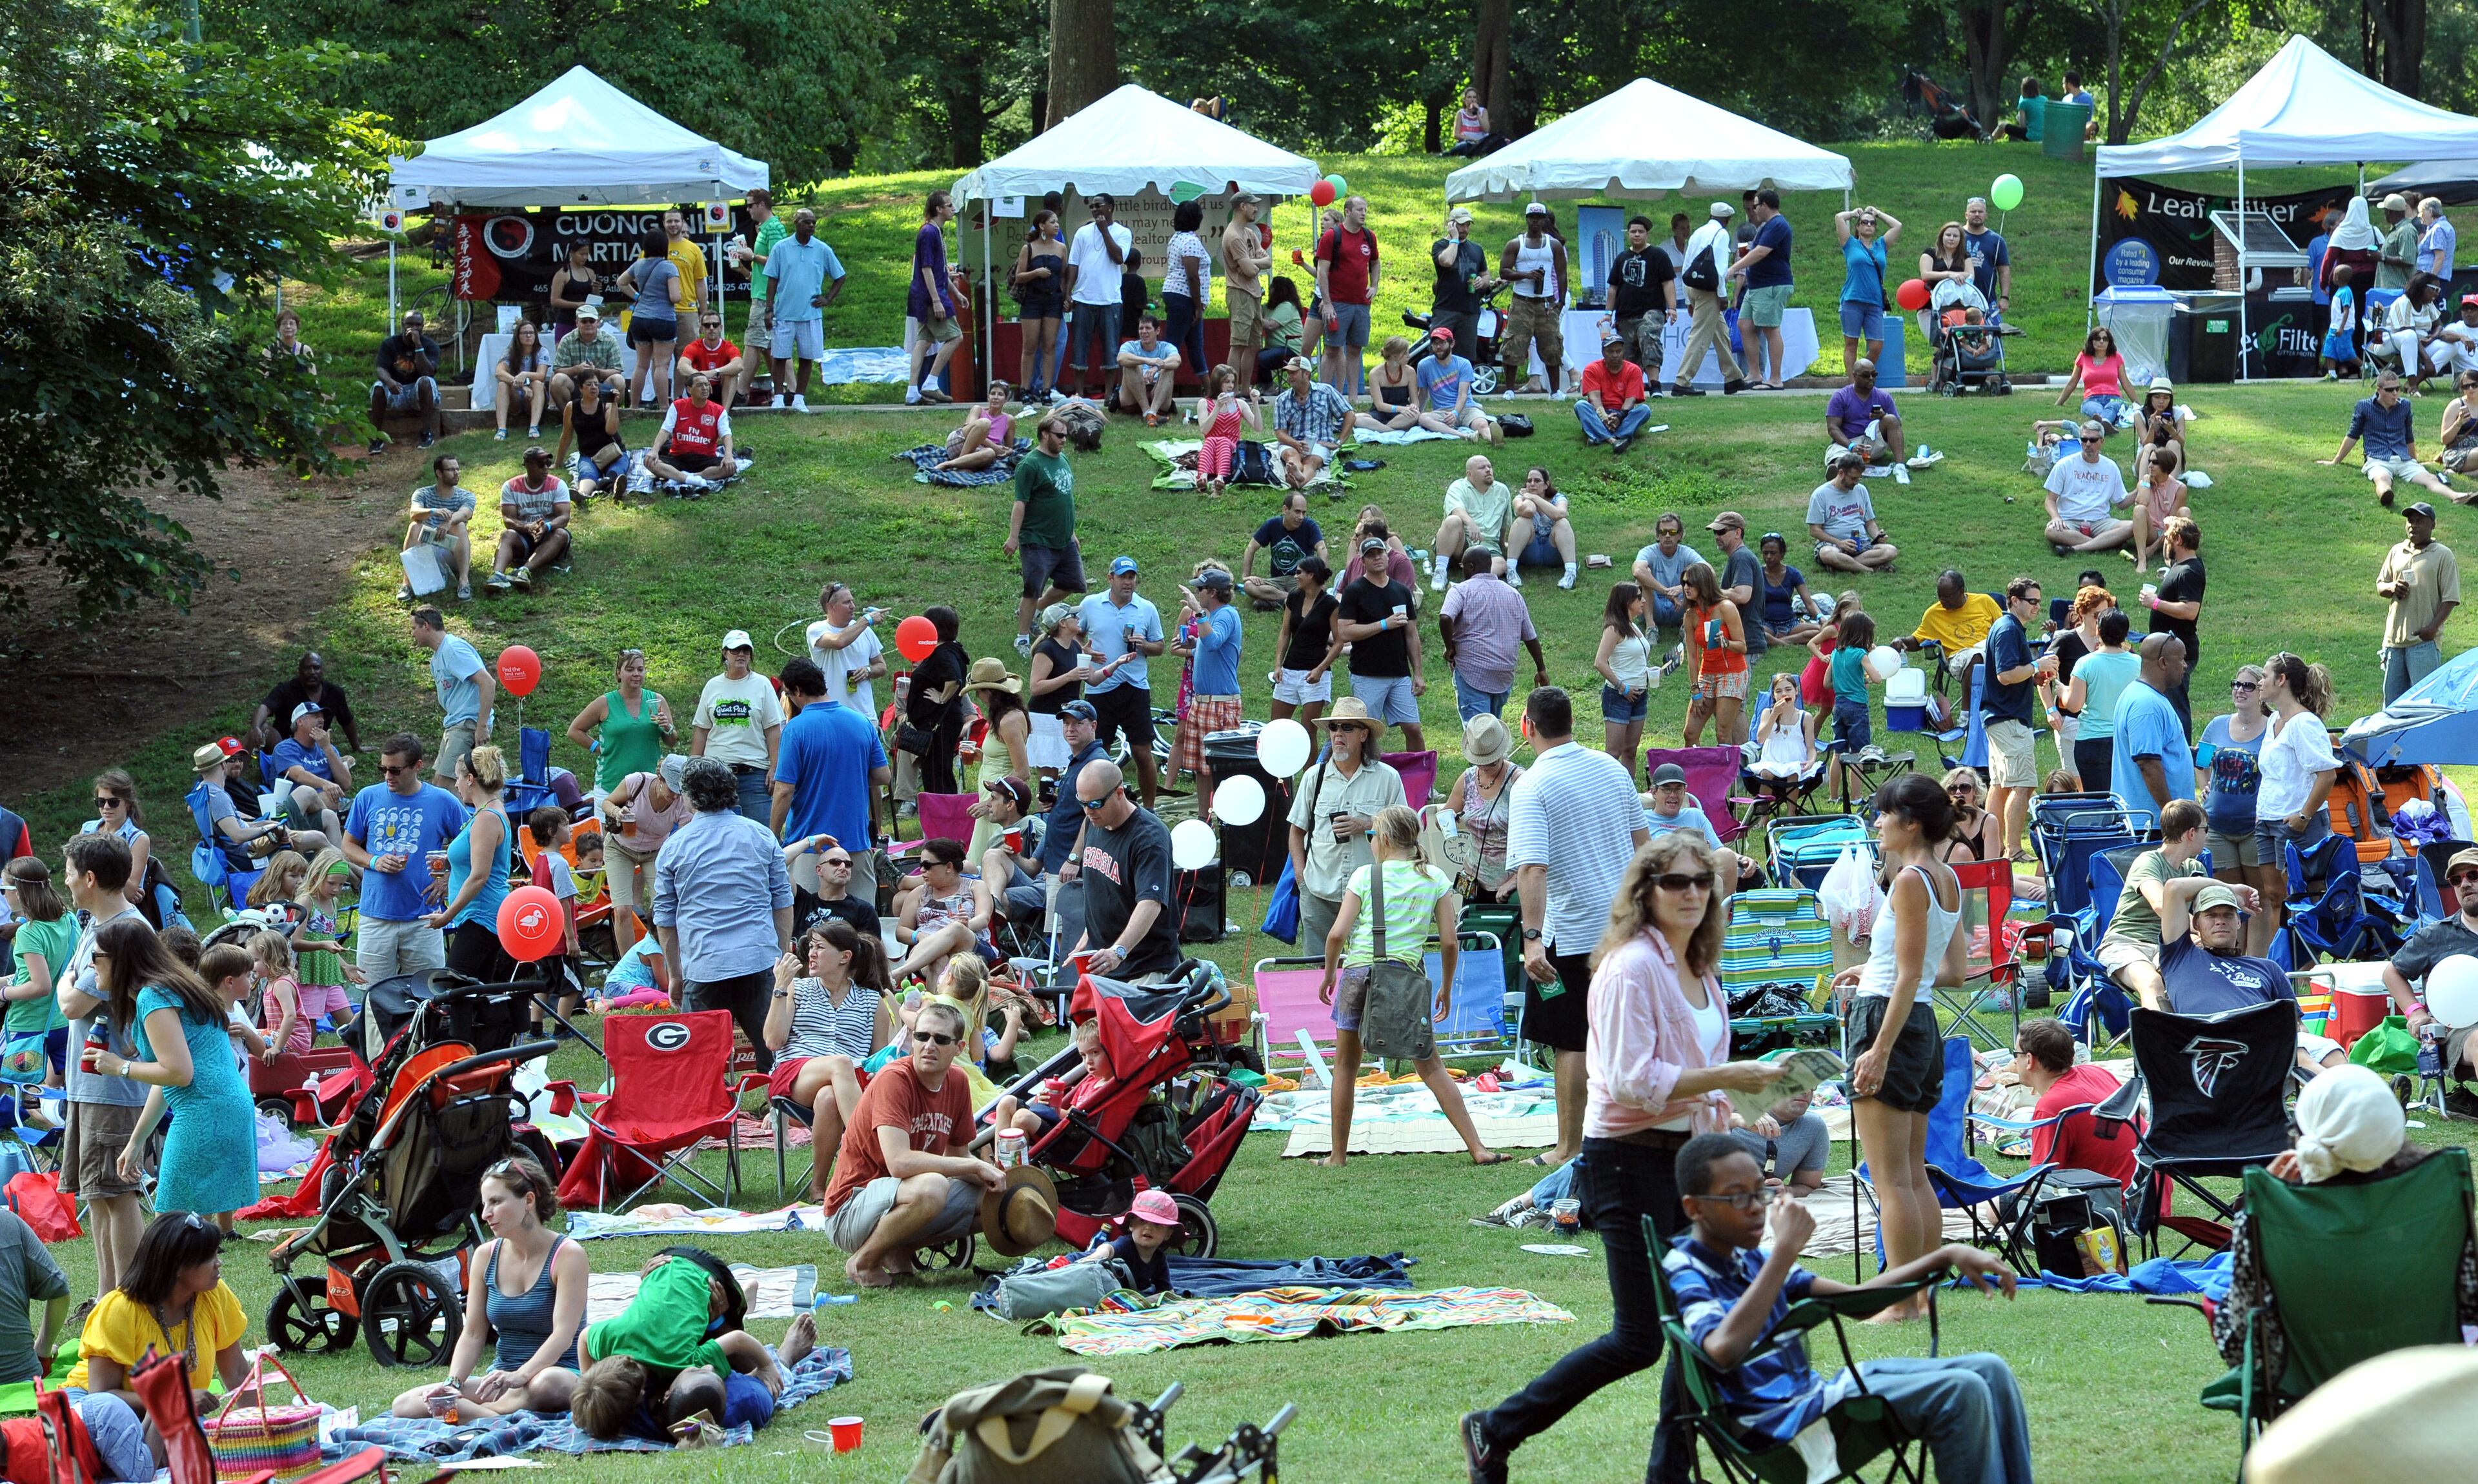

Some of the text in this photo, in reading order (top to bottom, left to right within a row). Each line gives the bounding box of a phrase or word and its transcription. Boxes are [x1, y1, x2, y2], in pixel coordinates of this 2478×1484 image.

[1115, 199, 1140, 211] ittle
[1211, 201, 1224, 210] us
[2148, 192, 2205, 218] Leaf
[556, 215, 659, 235] CUONG
[1132, 219, 1158, 231] may
[1132, 233, 1171, 245] ealtor
[552, 241, 735, 262] MRTIA RTS
[2120, 249, 2137, 257] Rated
[1141, 256, 1167, 267] roup
[2115, 258, 2122, 266] by
[2129, 258, 2150, 270] leading
[2168, 256, 2185, 266] Our
[2117, 268, 2146, 276] consumer
[2117, 276, 2145, 285] magazine
[738, 283, 752, 291] 470
[2279, 328, 2319, 352] Filte
[688, 426, 700, 436] Fly
[676, 432, 711, 445] Emirates
[716, 705, 747, 716] Grant Park
[1083, 847, 1121, 885] EORGIA
[1749, 927, 1800, 947] TOMMY BAHAMA
[648, 1025, 688, 1048] G
